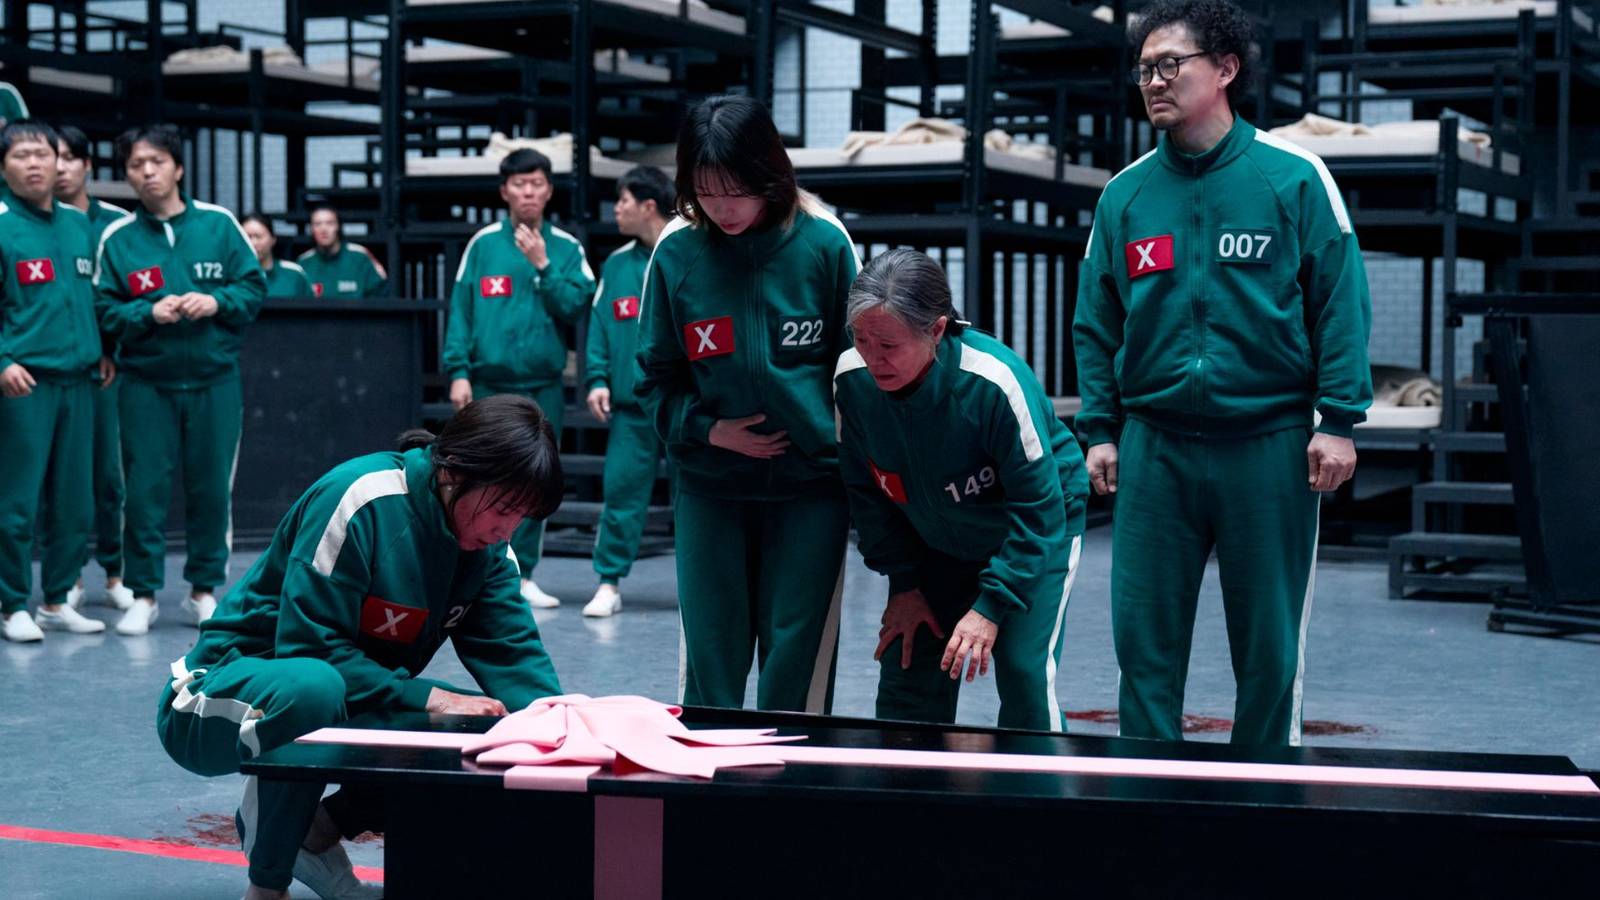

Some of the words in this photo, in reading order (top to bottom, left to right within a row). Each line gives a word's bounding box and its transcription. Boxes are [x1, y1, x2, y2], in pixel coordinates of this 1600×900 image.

[1135, 241, 1156, 270] X
[1218, 233, 1272, 259] 007
[27, 261, 45, 280] X
[136, 270, 155, 291] X
[194, 262, 223, 279] 172
[490, 277, 505, 295] X
[617, 299, 630, 317] X
[694, 324, 717, 353] X
[782, 319, 823, 346] 222
[944, 466, 996, 502] 149
[373, 607, 409, 636] X
